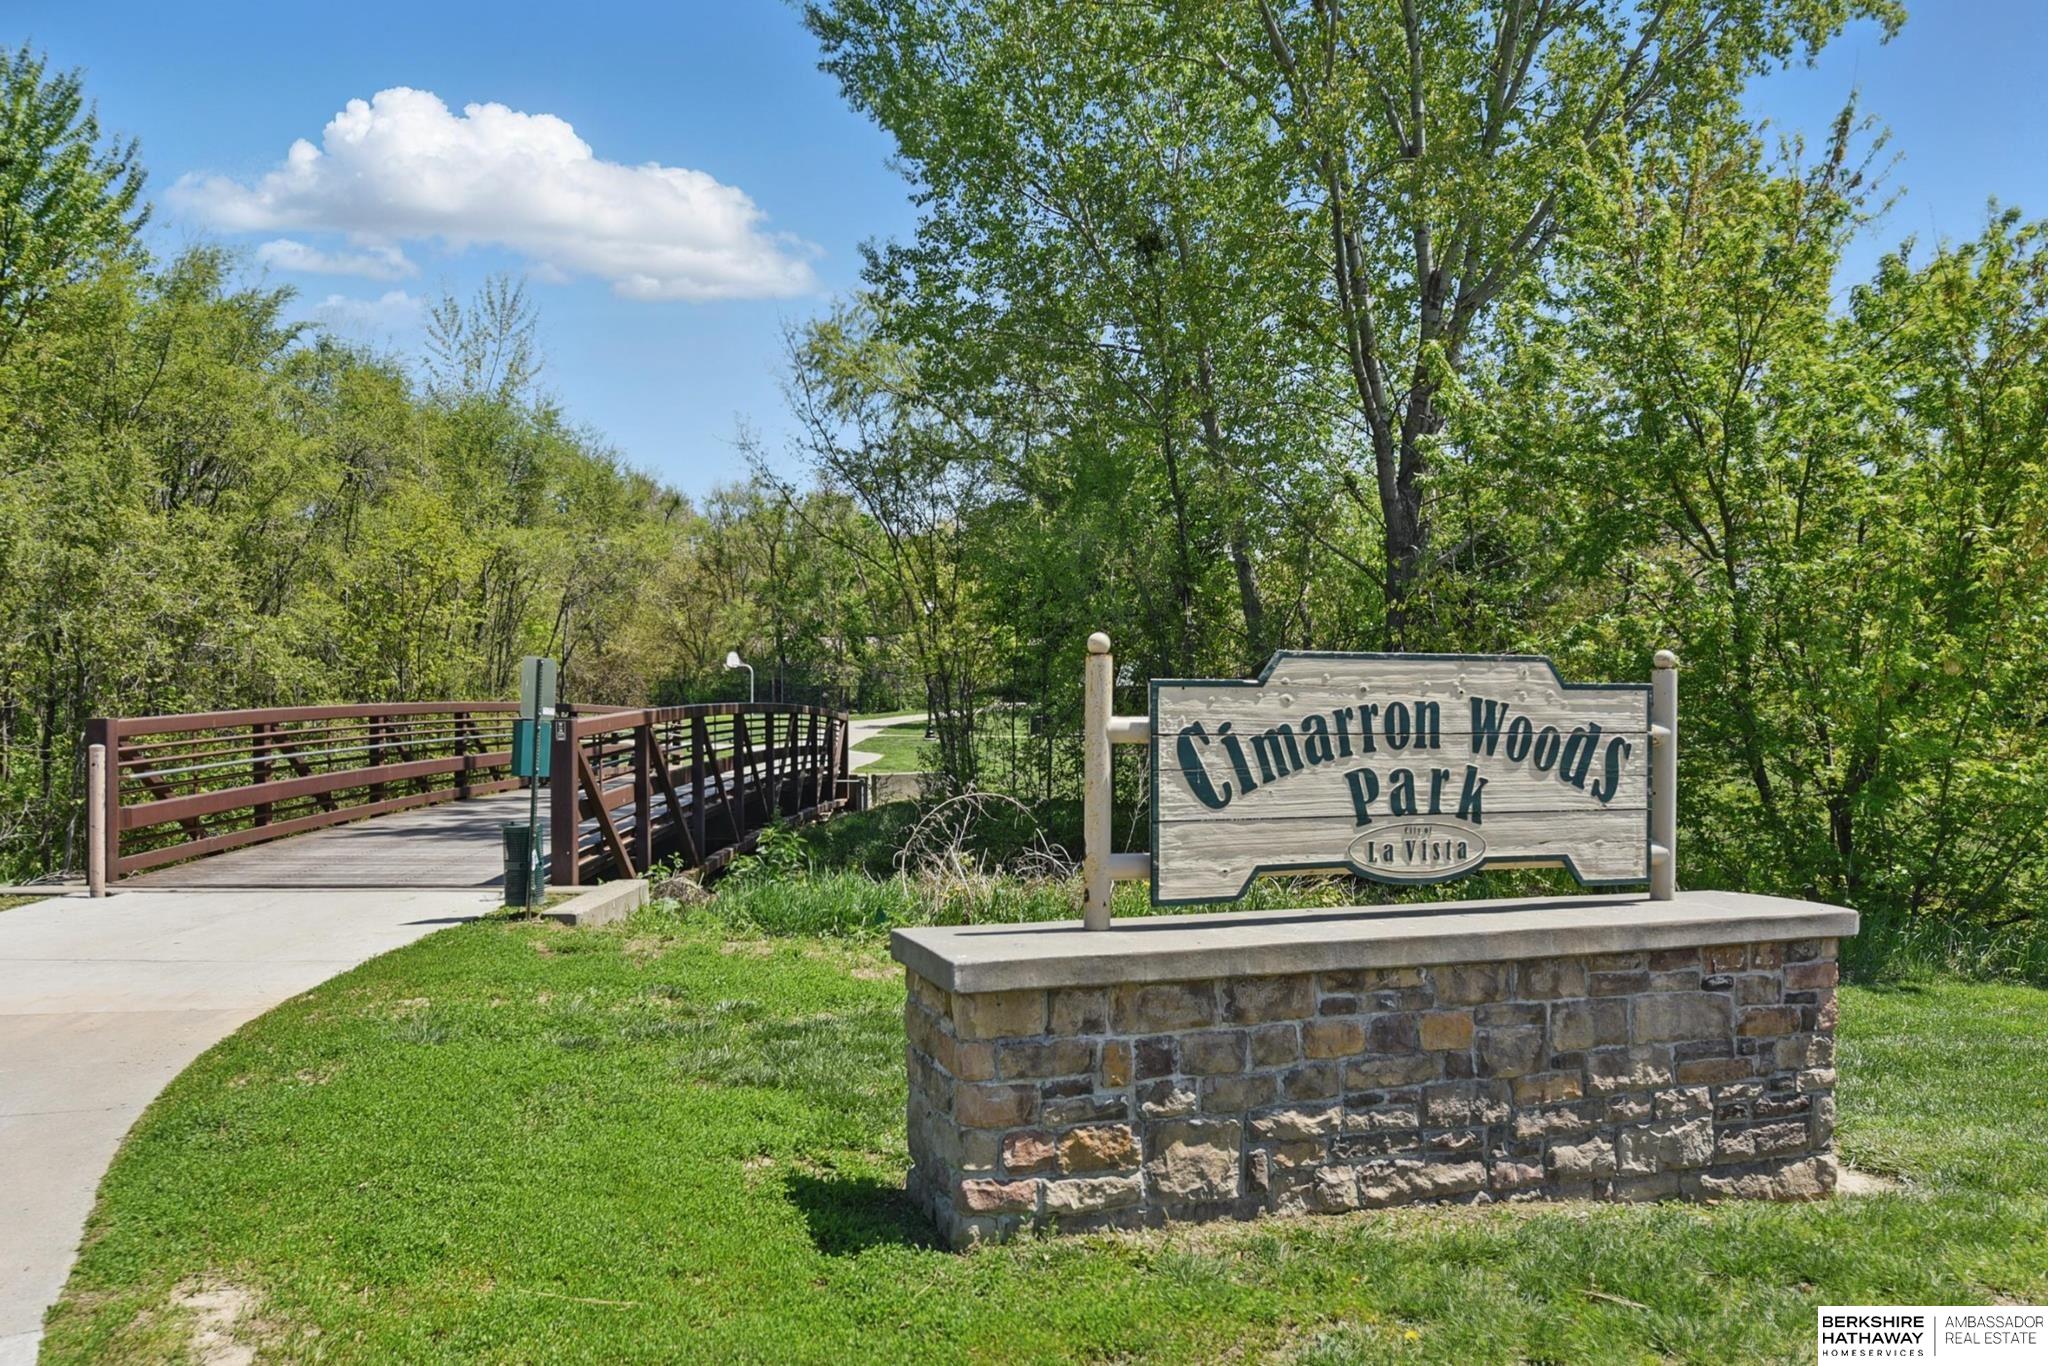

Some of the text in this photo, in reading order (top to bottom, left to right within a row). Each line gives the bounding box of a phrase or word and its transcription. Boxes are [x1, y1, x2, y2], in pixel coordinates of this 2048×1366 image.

[1177, 697, 1631, 809] Cimarron Woods
[1344, 765, 1488, 827] Park
[1368, 839, 1468, 862] La Vista
[1404, 826, 1432, 836] City of
